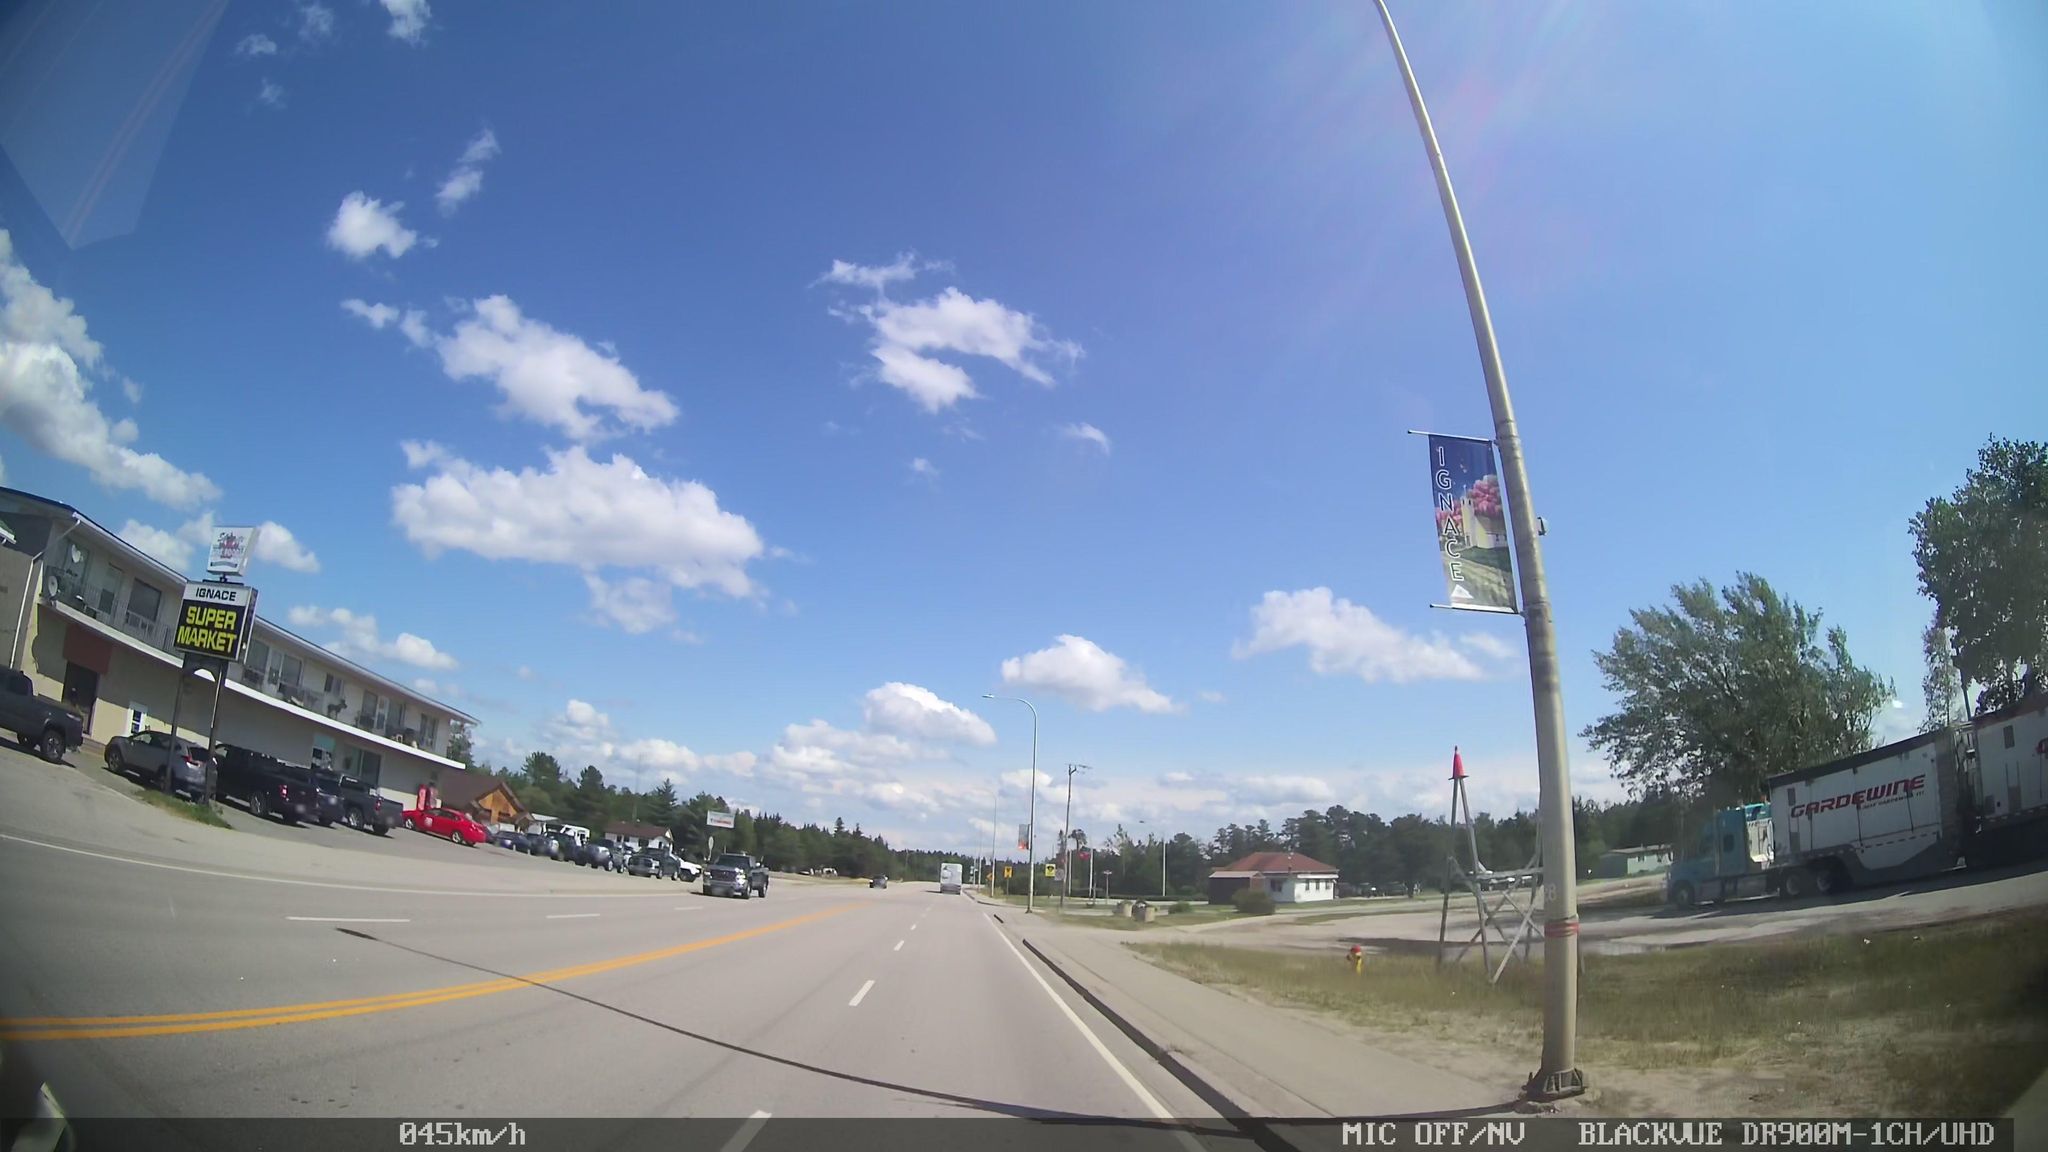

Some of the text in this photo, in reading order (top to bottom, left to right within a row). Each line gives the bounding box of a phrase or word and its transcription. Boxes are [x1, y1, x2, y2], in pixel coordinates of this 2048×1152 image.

[1436, 446, 1464, 581] IGNACE
[195, 587, 237, 602] IGNACE
[186, 606, 237, 630] SUPER
[177, 625, 238, 653] MARKET
[1790, 774, 1926, 818] GARDEWINE
